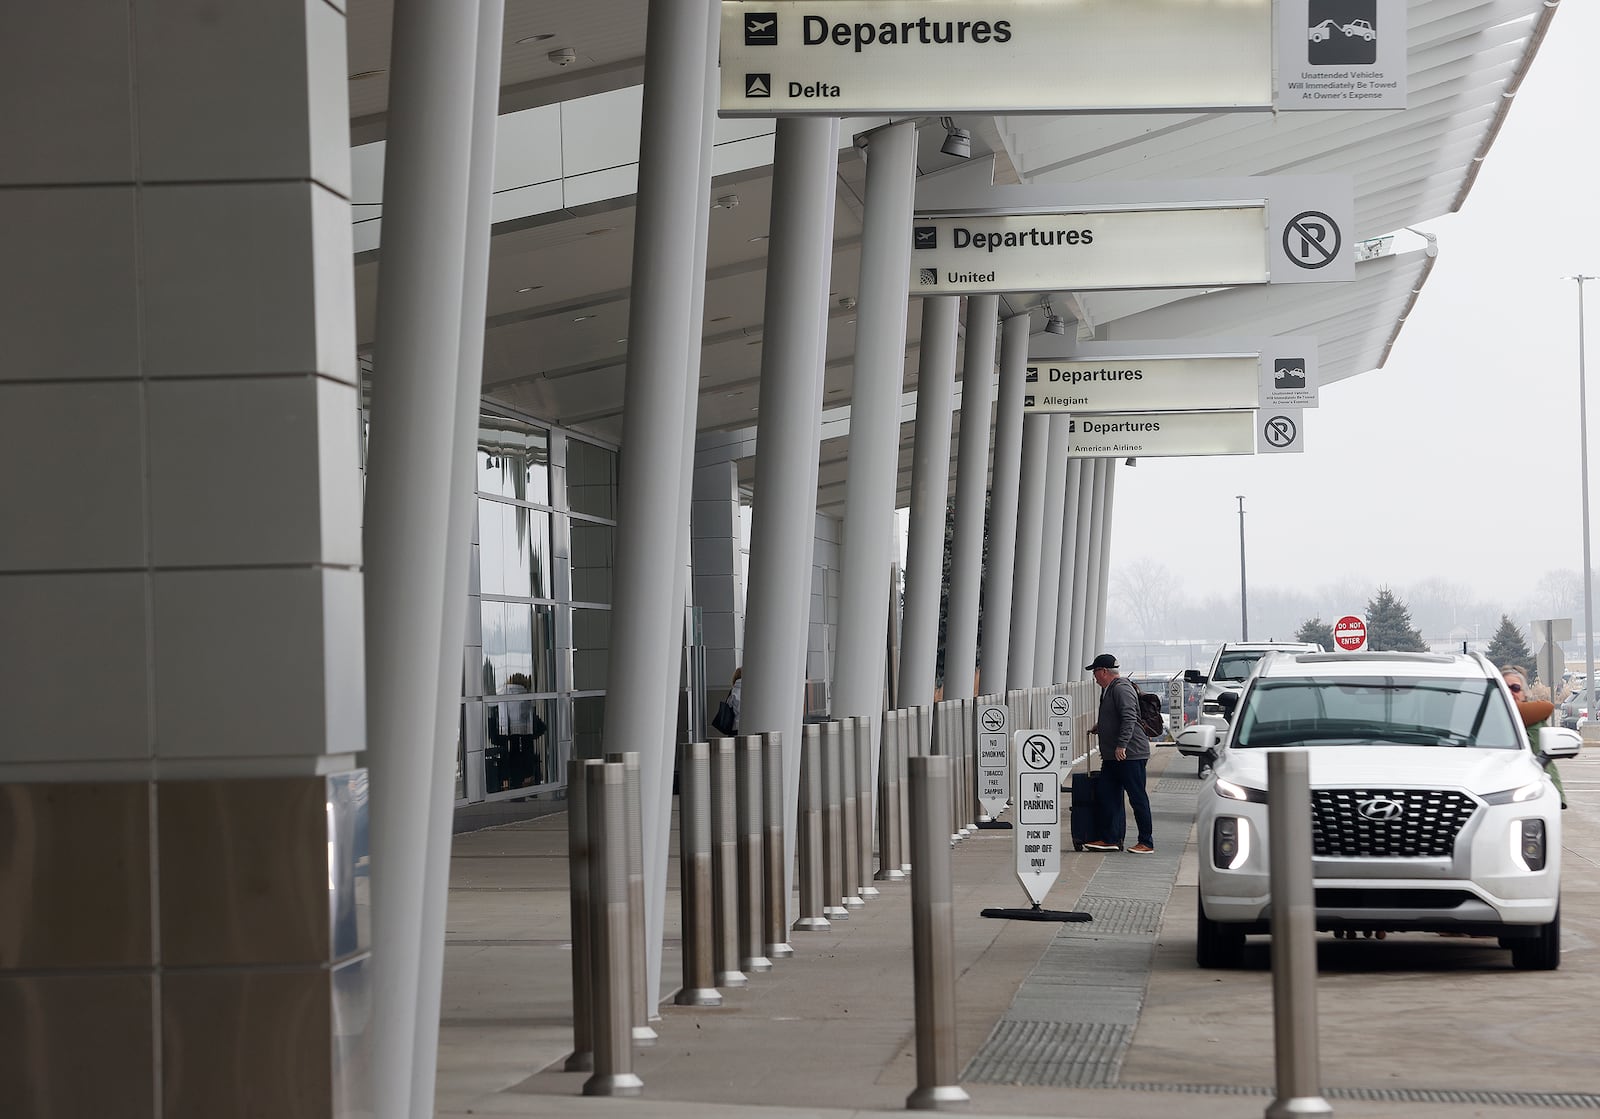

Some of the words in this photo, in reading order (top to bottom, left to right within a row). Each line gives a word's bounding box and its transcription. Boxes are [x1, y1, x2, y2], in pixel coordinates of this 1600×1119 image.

[803, 15, 1012, 52] Departures
[1301, 71, 1349, 79] Unattended
[1350, 71, 1384, 79] Vehicles
[788, 81, 841, 98] Delta
[1305, 82, 1355, 90] Immediately
[1313, 91, 1347, 99] Owner's
[1349, 91, 1383, 99] Expense
[953, 228, 1094, 252] Departures
[948, 271, 995, 283] United
[1049, 368, 1143, 385] Departures
[1043, 396, 1088, 406] Allegiant
[1083, 421, 1160, 435] Departures
[1338, 622, 1347, 630] DO
[1341, 637, 1361, 645] ENTER
[989, 739, 997, 747] NO
[982, 750, 1005, 758] SMOKING
[1033, 782, 1044, 793] NO
[1023, 800, 1054, 810] PARKING
[1026, 830, 1041, 839] PICK
[1042, 830, 1051, 839] UP
[1024, 844, 1041, 853] DROP
[1041, 844, 1053, 853] OFF
[1030, 858, 1046, 867] ONLY
